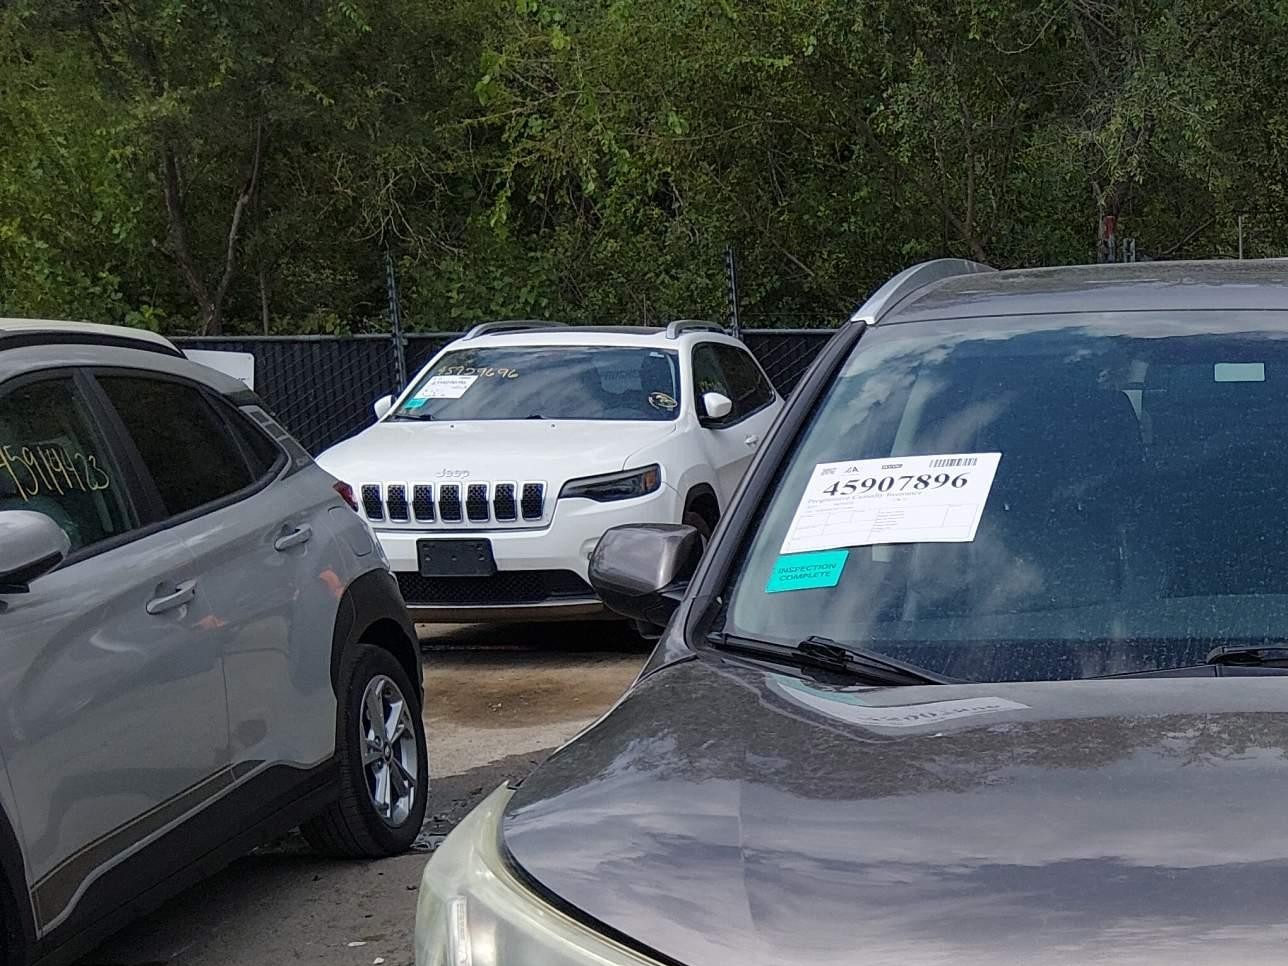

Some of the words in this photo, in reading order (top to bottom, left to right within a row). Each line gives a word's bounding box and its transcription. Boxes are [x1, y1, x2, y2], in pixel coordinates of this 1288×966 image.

[435, 468, 470, 480] Jeep
[822, 471, 971, 496] 45907896
[777, 563, 837, 574] INSPECTION
[778, 571, 832, 581] COMPLETE
